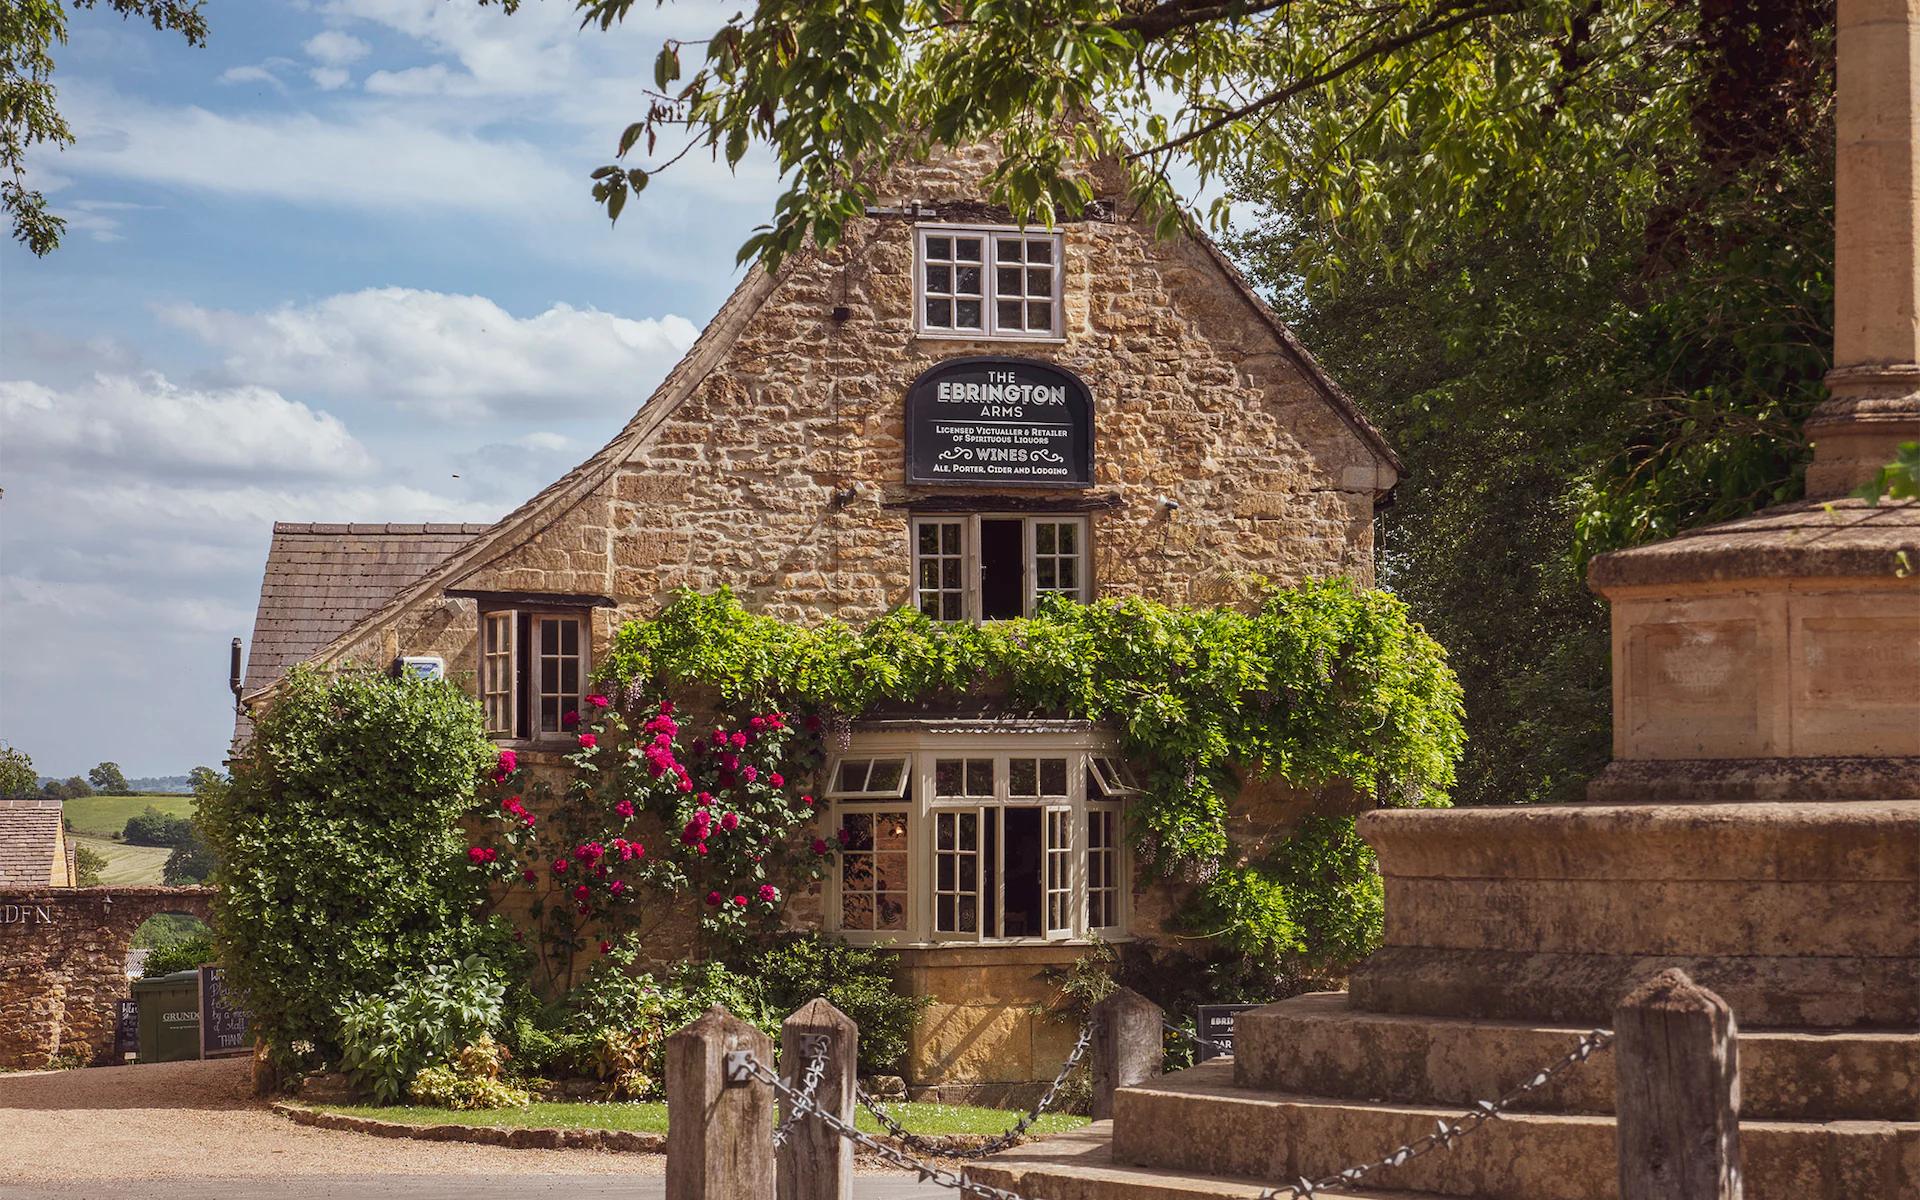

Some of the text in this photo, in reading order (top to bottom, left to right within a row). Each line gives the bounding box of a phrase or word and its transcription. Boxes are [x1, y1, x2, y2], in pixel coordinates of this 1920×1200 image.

[988, 371, 1016, 383] THE
[937, 382, 1066, 406] EBRINGTON
[980, 405, 1024, 418] ARMS
[952, 434, 963, 442] OF
[975, 447, 1028, 462] WINES
[1013, 466, 1031, 474] AND
[162, 1011, 200, 1022] GRUND
[1210, 1017, 1234, 1026] EBRI
